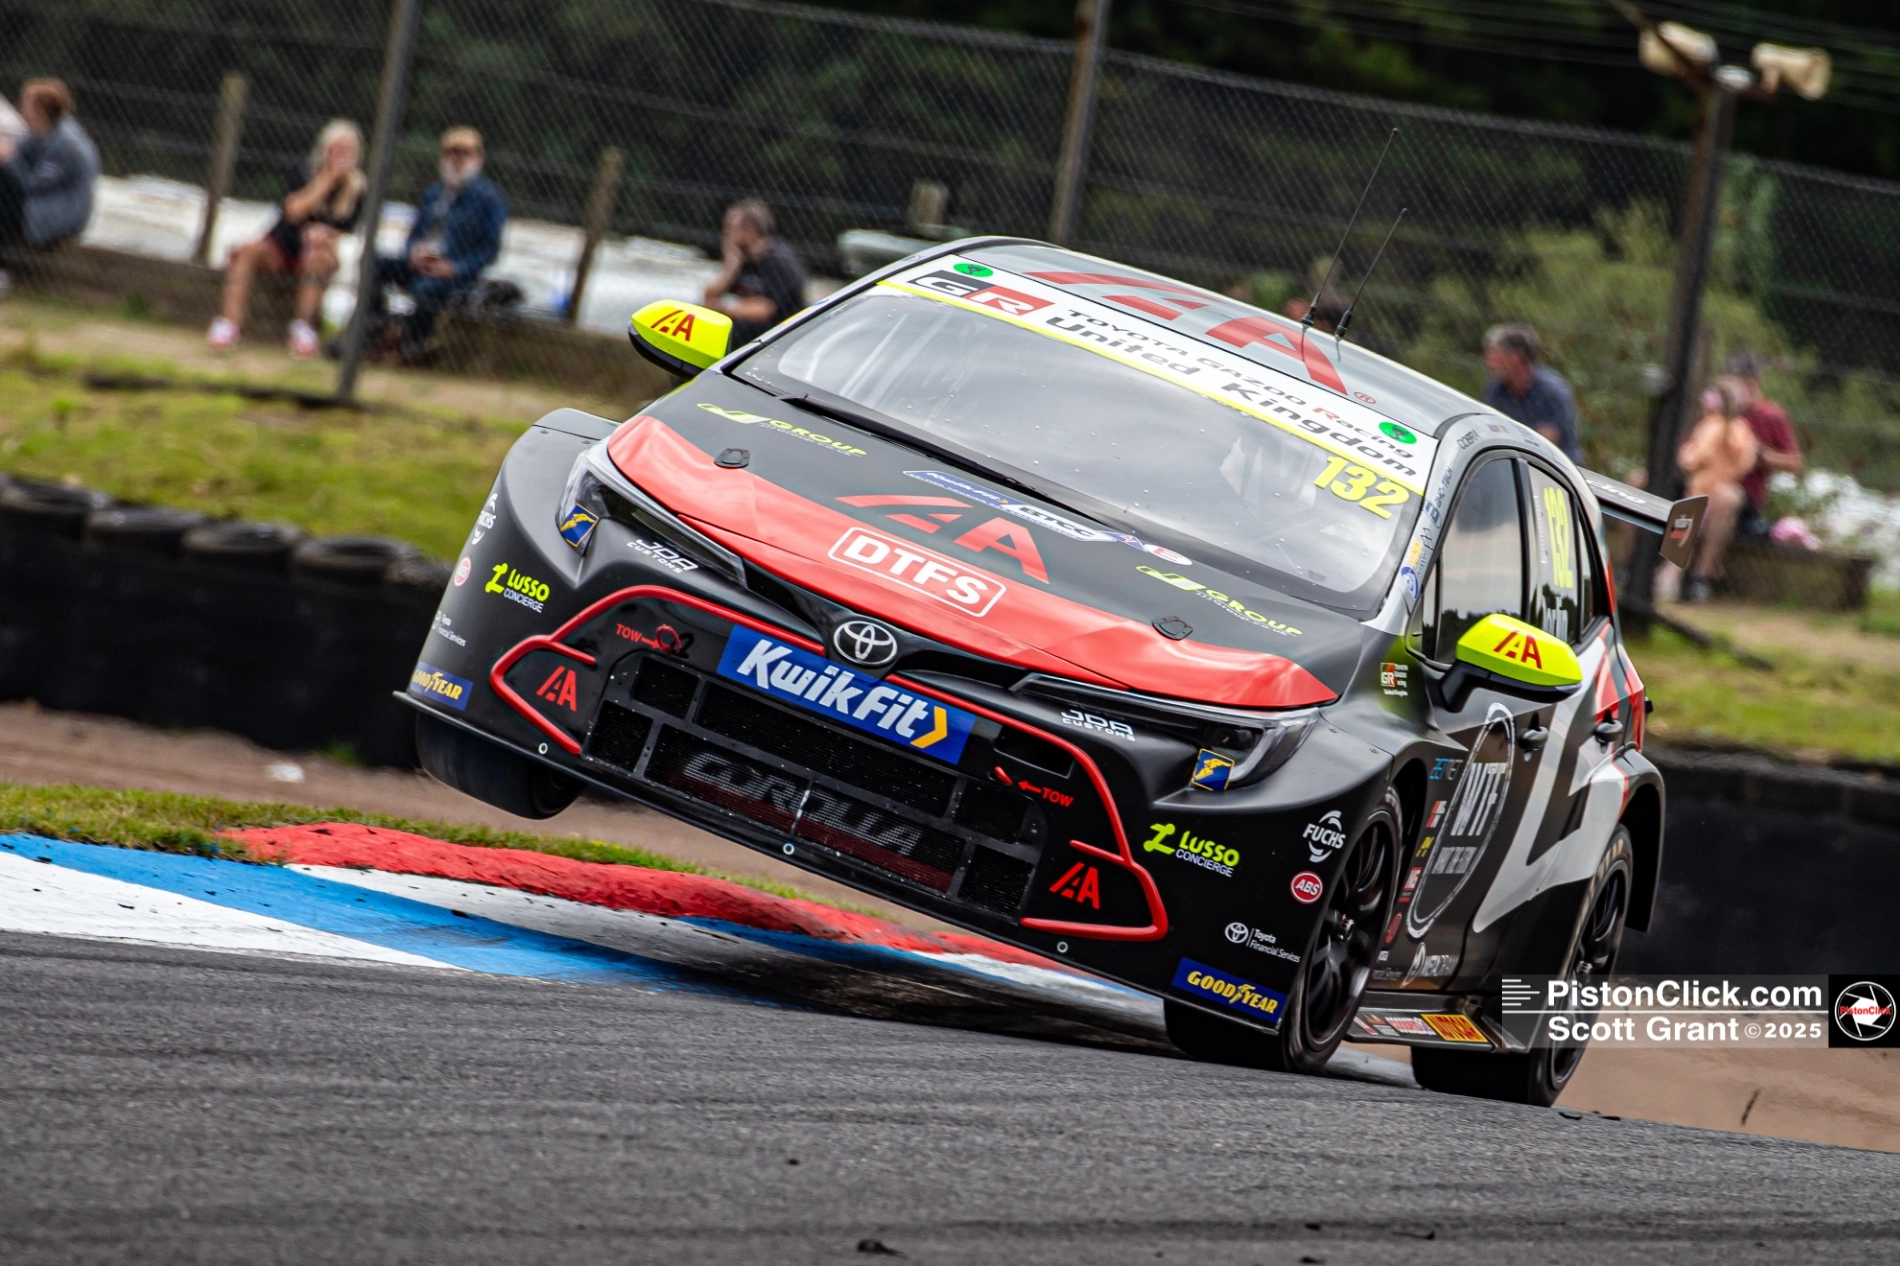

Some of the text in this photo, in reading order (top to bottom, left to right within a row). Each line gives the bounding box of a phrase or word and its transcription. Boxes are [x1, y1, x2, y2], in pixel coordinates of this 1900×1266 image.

[1045, 316, 1417, 476] United Kingdom
[1068, 309, 1414, 459] TOYOTA GAZOO Racing
[769, 419, 868, 456] GROUP
[1313, 456, 1410, 520] 132
[1543, 486, 1574, 589] 132
[626, 541, 684, 574] CUSTOMS
[635, 539, 699, 571] JDA
[842, 534, 989, 605] DTFS
[503, 588, 545, 614] CONCIERGE
[506, 568, 550, 602] LUSSO
[1205, 588, 1303, 636] GROUP
[616, 623, 642, 643] TOW
[1060, 709, 1134, 736] JDA
[1062, 718, 1136, 742] CUSTOMS
[1042, 786, 1074, 808] TOW
[1178, 830, 1240, 867] LUSSO
[1302, 820, 1347, 850] FUCHS
[1175, 848, 1235, 878] CONCIERGE
[1294, 877, 1321, 895] ABS
[1249, 939, 1301, 963] Financial Services
[1253, 928, 1277, 944] Toyota
[1187, 970, 1279, 1015] GOODYEAR
